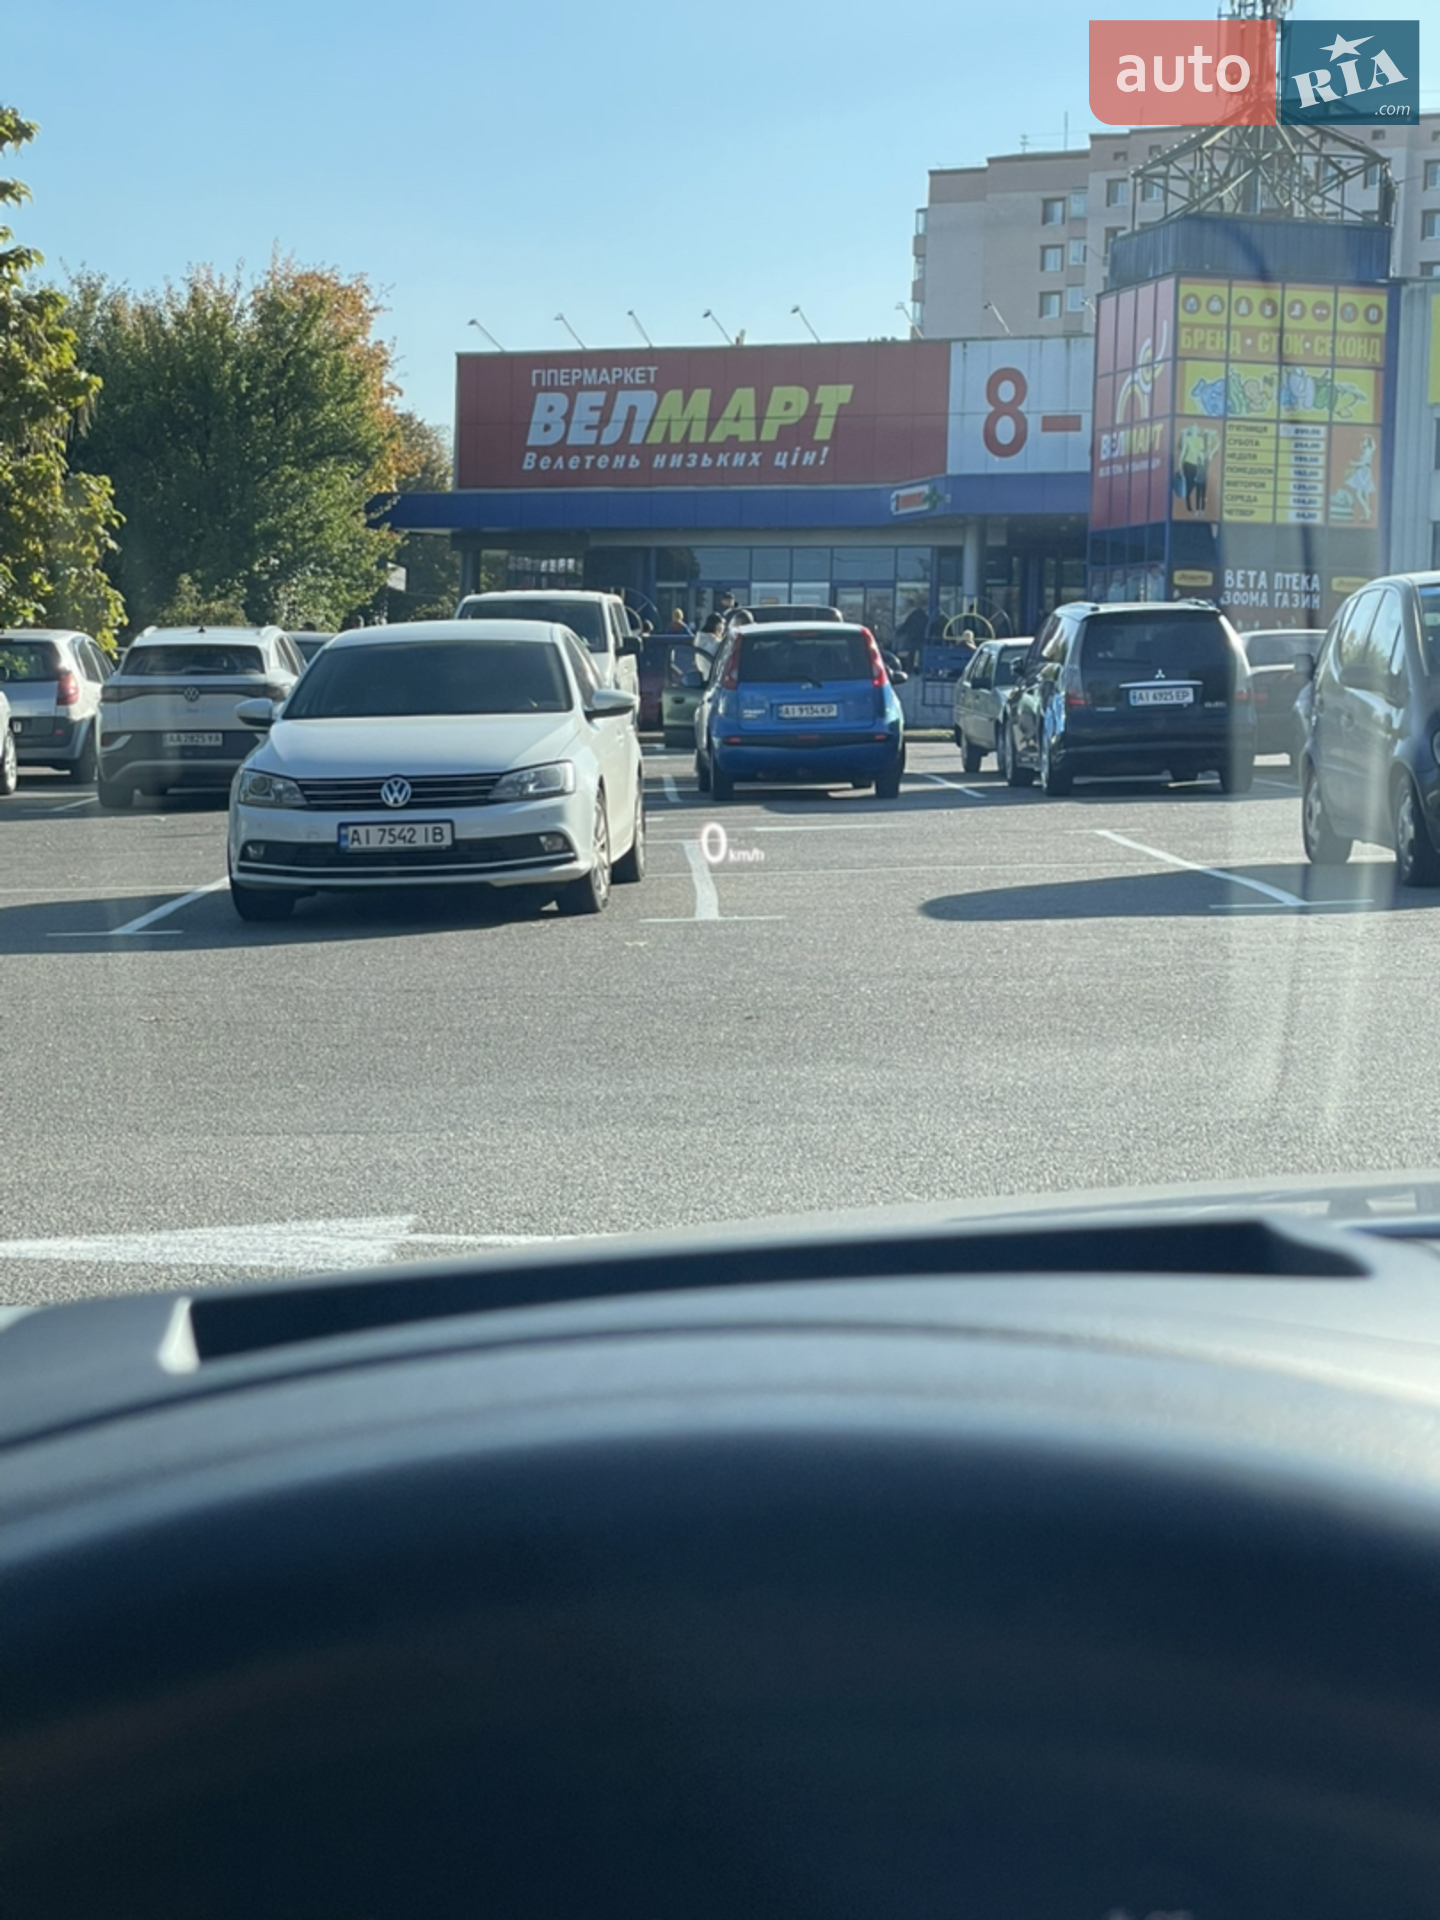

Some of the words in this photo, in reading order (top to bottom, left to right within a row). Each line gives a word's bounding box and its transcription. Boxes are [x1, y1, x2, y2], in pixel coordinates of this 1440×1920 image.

[1180, 328, 1242, 355] БРЕНД
[1258, 332, 1305, 356] СТОК
[1314, 335, 1381, 363] СЕКОНД
[531, 366, 659, 387] ГІПЕРМАРКЕТ
[526, 385, 854, 446] ВЕЛМАРТ
[1227, 438, 1261, 447] СУБОТА
[522, 451, 641, 471] Велетень
[653, 451, 763, 468] низьких
[774, 447, 830, 468] цін!
[1225, 494, 1259, 503] СЕРЕДА
[350, 828, 371, 845] AI
[378, 827, 417, 845] 7542
[424, 826, 445, 844] IB
[701, 821, 728, 864] 0
